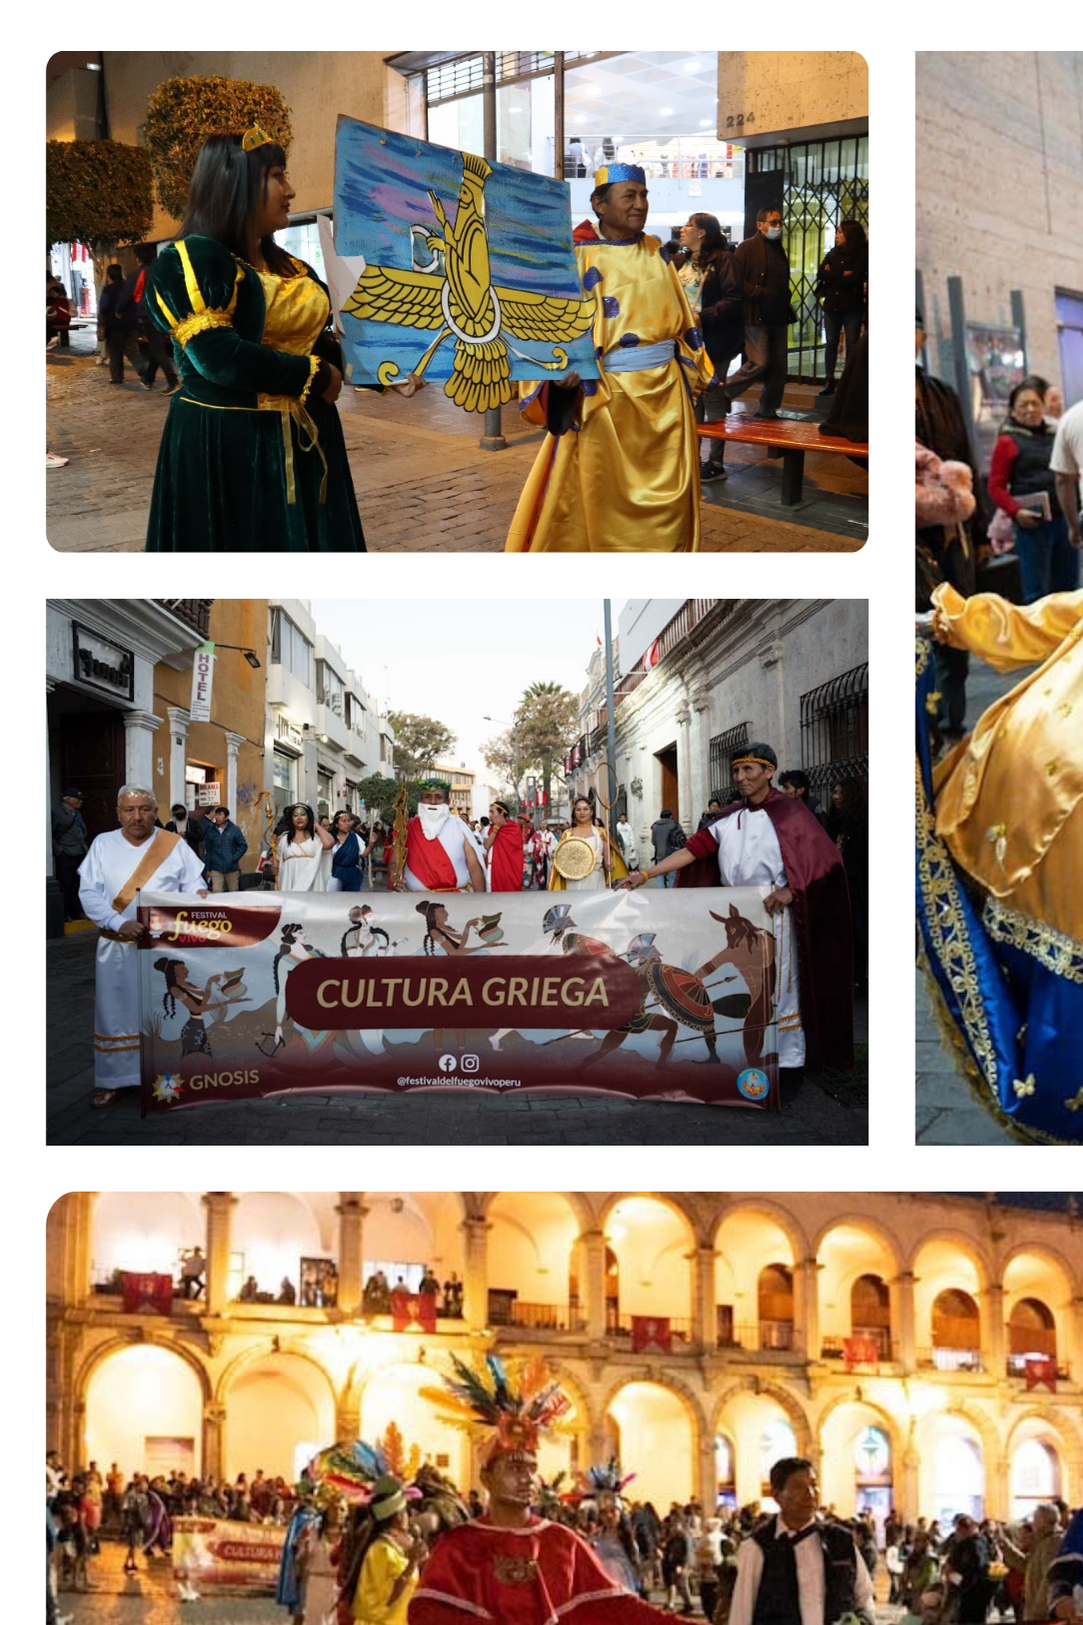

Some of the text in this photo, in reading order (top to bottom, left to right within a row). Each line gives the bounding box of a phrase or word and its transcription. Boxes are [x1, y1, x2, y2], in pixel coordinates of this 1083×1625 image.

[726, 112, 755, 128] 224
[196, 653, 210, 701] HOTEL
[191, 911, 227, 919] FESTIVAL
[168, 911, 232, 940] fuego
[179, 935, 207, 943] VIVO
[316, 977, 609, 1008] CULTURA GRIEGA
[189, 1069, 260, 1090] GNOSIS
[397, 1076, 521, 1088] @festivaldelfuegovivoperu
